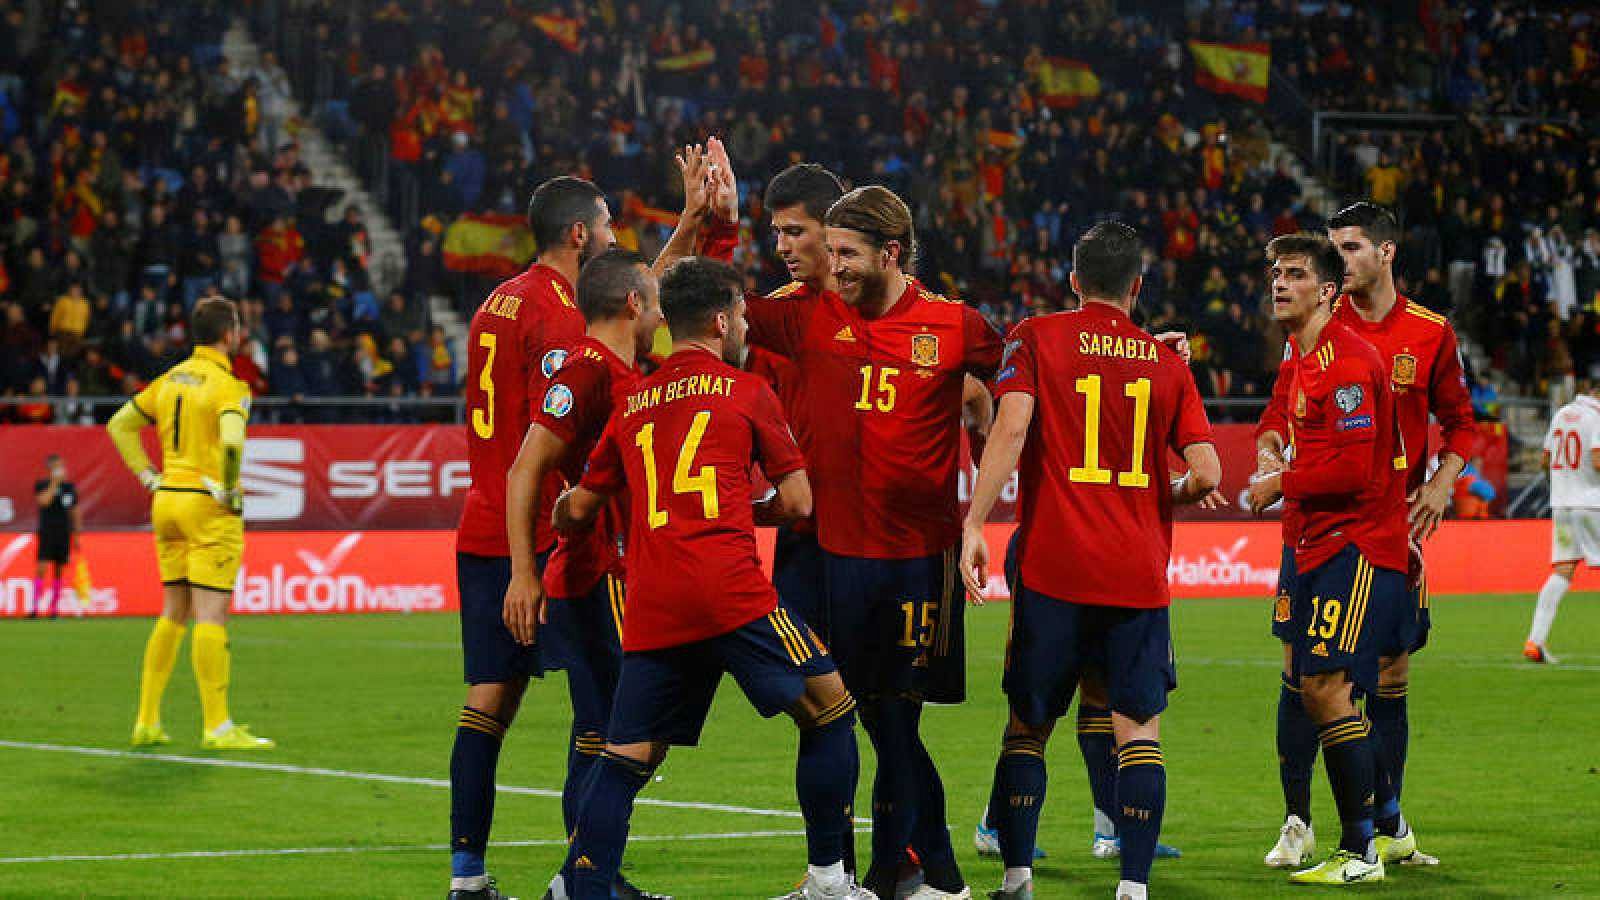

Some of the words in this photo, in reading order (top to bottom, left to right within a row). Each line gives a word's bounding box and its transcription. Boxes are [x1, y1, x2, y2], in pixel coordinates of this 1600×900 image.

[1079, 331, 1159, 363] SARABIA
[471, 332, 497, 439] 3
[623, 386, 663, 418] JUAN
[666, 373, 736, 403] BERNAT
[855, 364, 900, 413] 15
[172, 392, 185, 452] 1
[1069, 373, 1152, 489] 11
[635, 410, 720, 530] 14
[1551, 427, 1583, 471] 20
[896, 601, 938, 647] 15
[1307, 596, 1341, 639] 19
